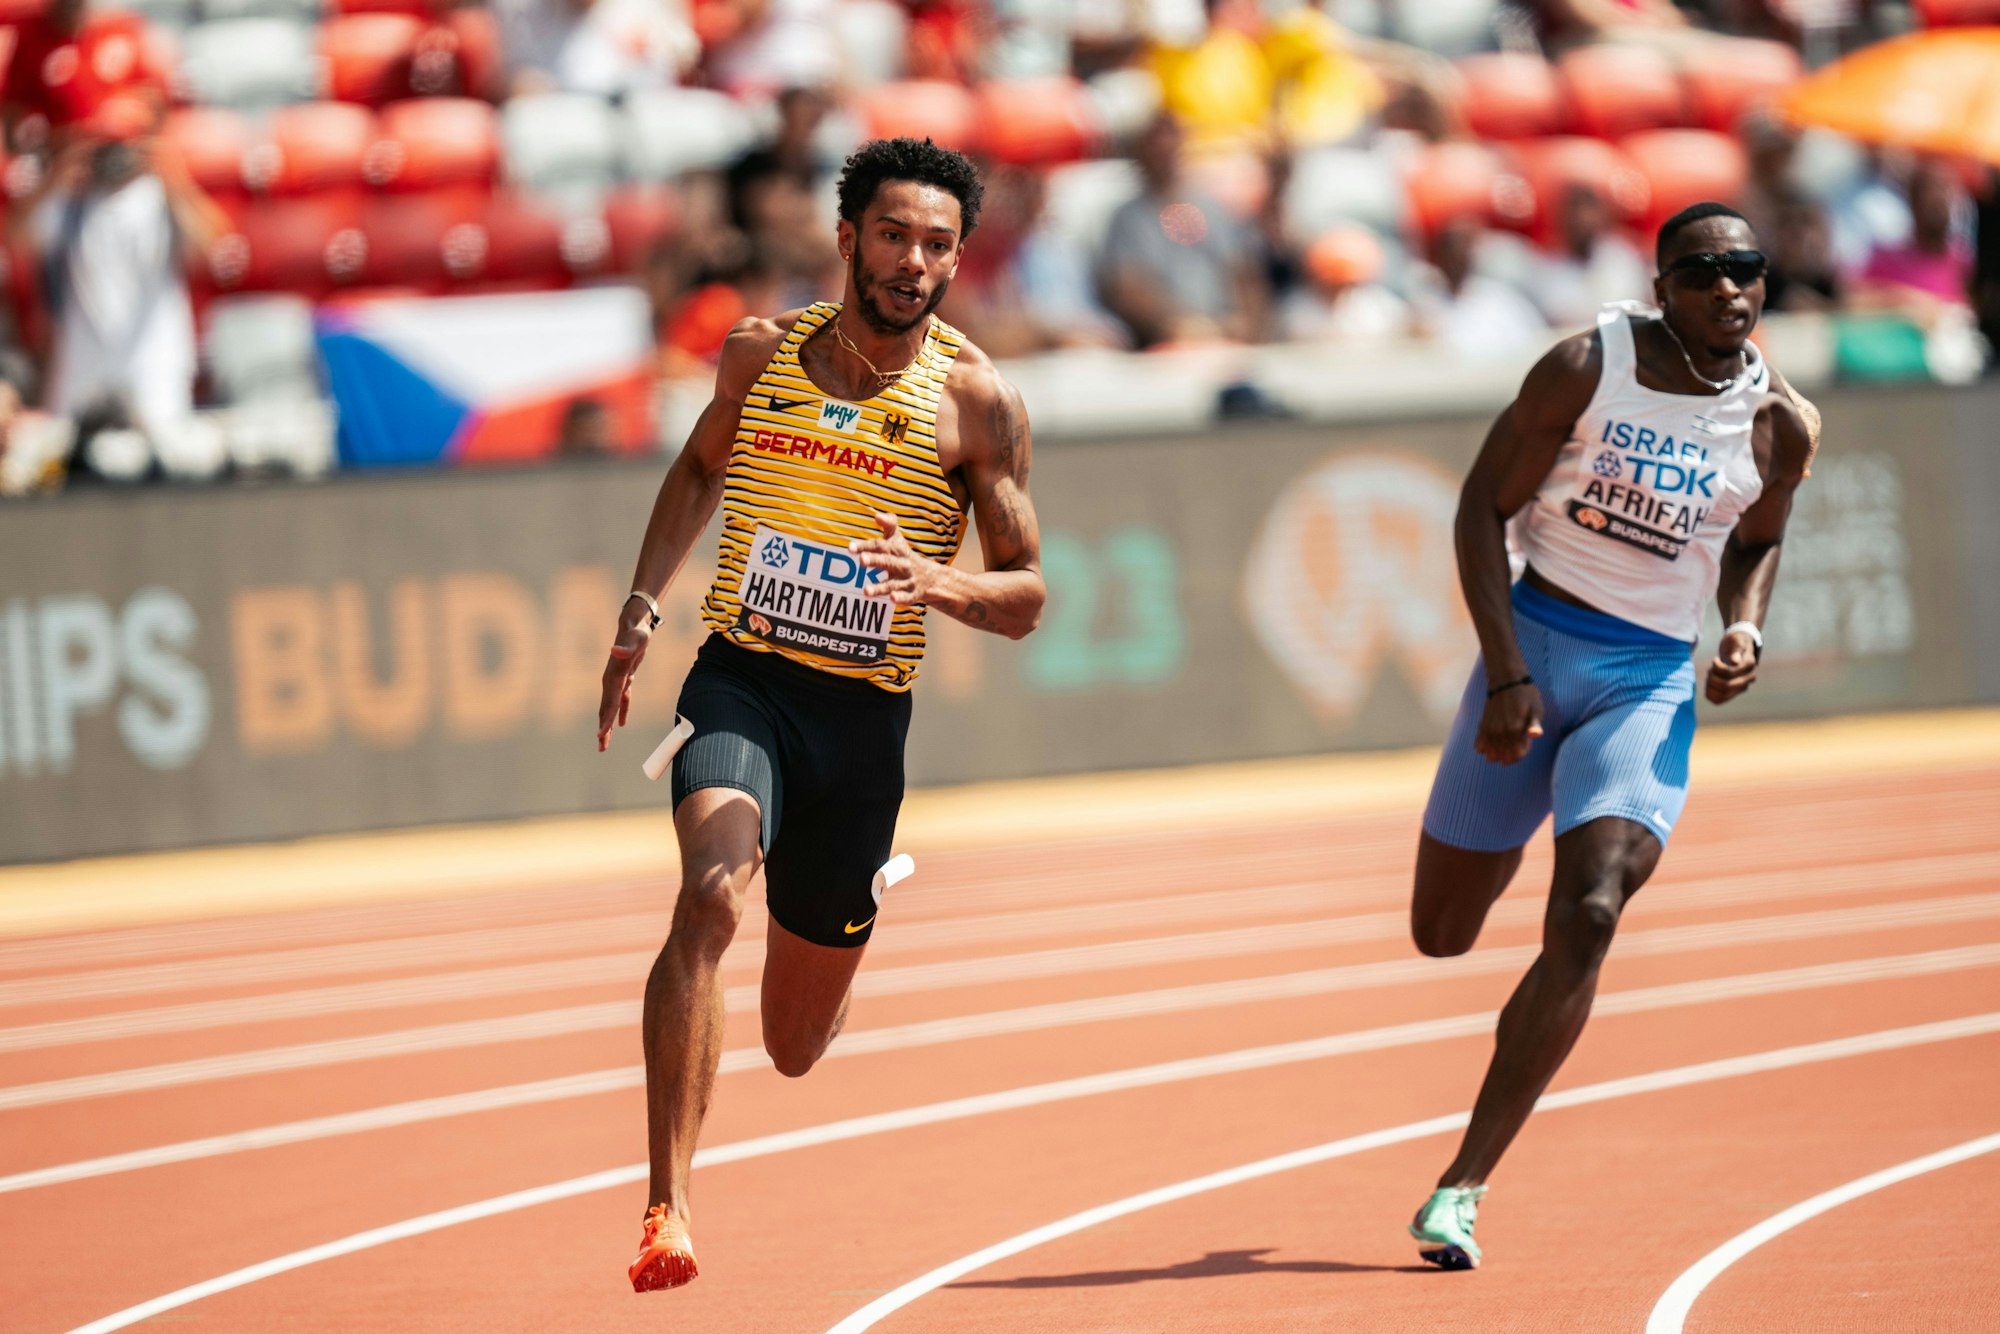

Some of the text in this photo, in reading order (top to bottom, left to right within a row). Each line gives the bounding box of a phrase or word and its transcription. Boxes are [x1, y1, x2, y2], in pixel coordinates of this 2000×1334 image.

[754, 429, 898, 480] GERMANY
[1625, 456, 1717, 497] TDK
[1583, 479, 1710, 533] AFRIFAH
[791, 542, 889, 589] TDK
[745, 572, 887, 634] HARTMANN
[776, 624, 877, 658] BUDAPEST 23
[0, 586, 212, 772] IPS
